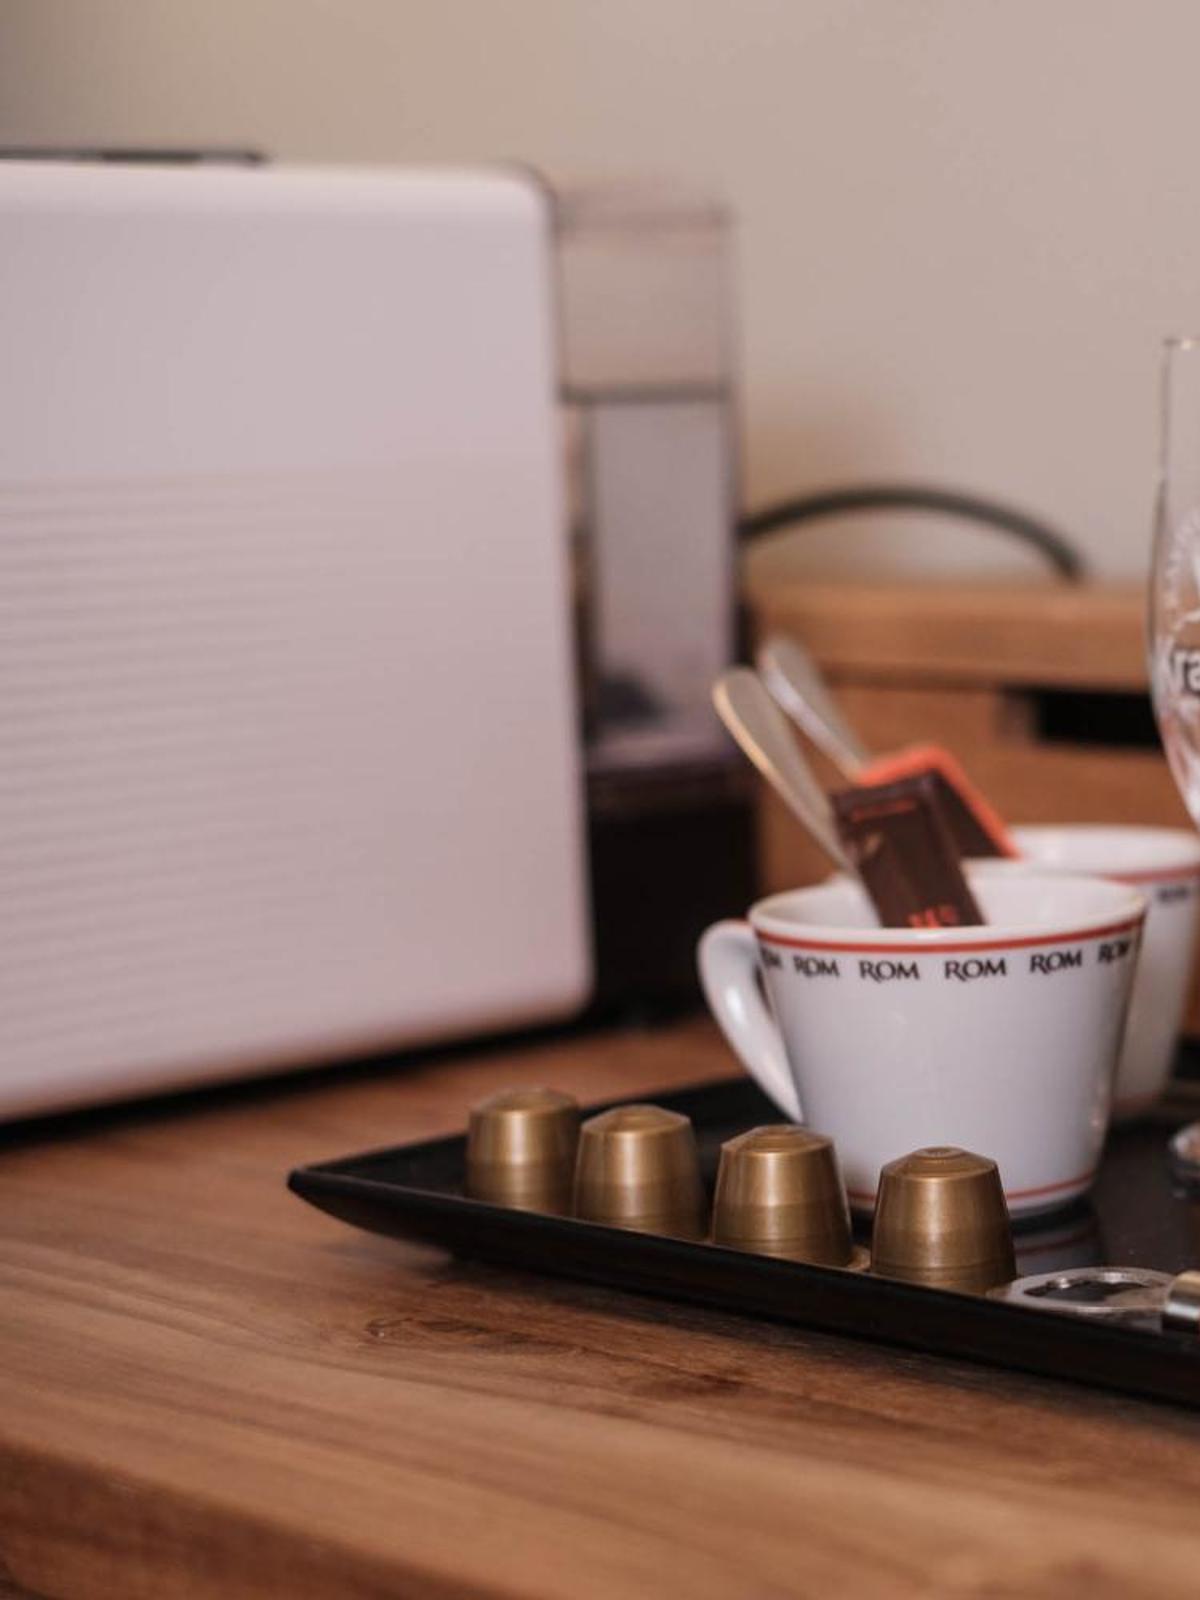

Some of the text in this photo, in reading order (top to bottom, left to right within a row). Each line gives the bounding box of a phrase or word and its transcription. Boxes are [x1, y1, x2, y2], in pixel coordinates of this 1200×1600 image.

[859, 960, 920, 982] ROM
[944, 957, 1008, 982] ROM
[1029, 949, 1083, 974] ROM
